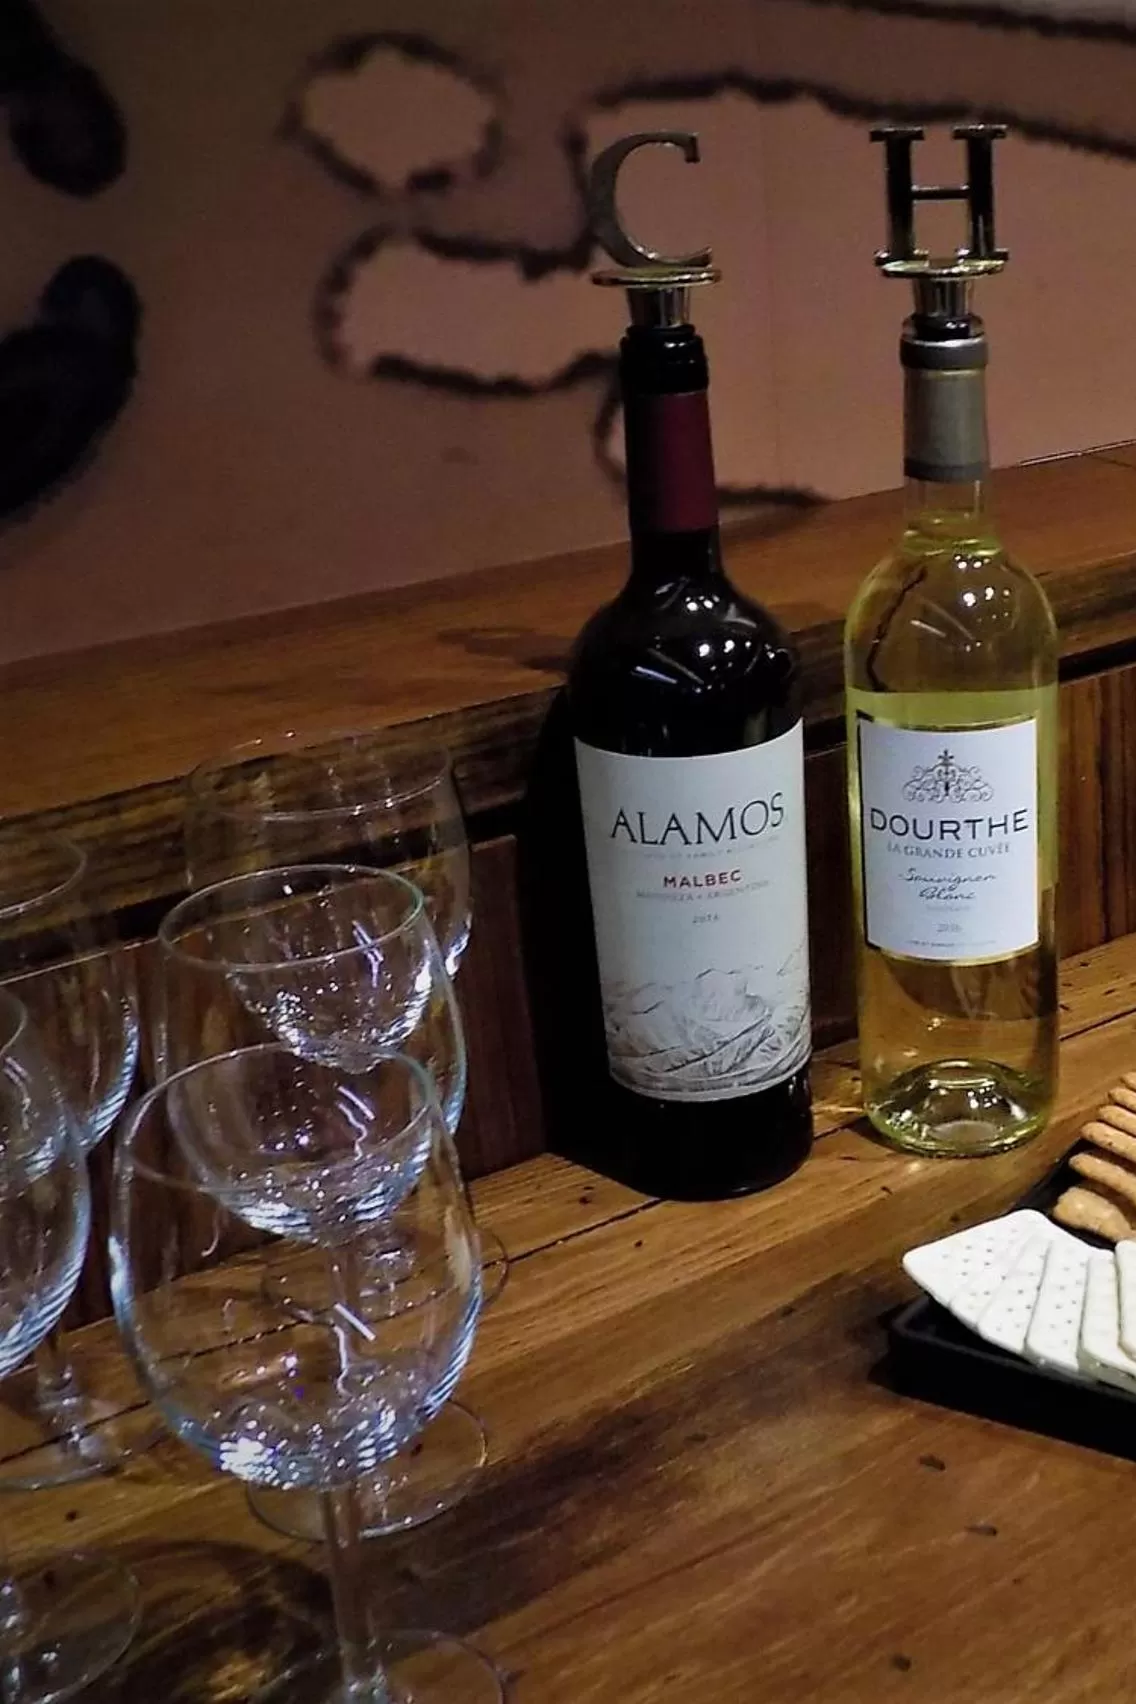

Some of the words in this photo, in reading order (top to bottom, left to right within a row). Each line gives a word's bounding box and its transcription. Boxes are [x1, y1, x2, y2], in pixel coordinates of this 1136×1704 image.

[590, 131, 712, 268] C
[869, 123, 1009, 266] H
[610, 792, 784, 845] ALAMOS
[870, 807, 1028, 841] DOURTHE
[904, 846, 963, 859] GRANDE
[663, 869, 742, 888] MALBEC
